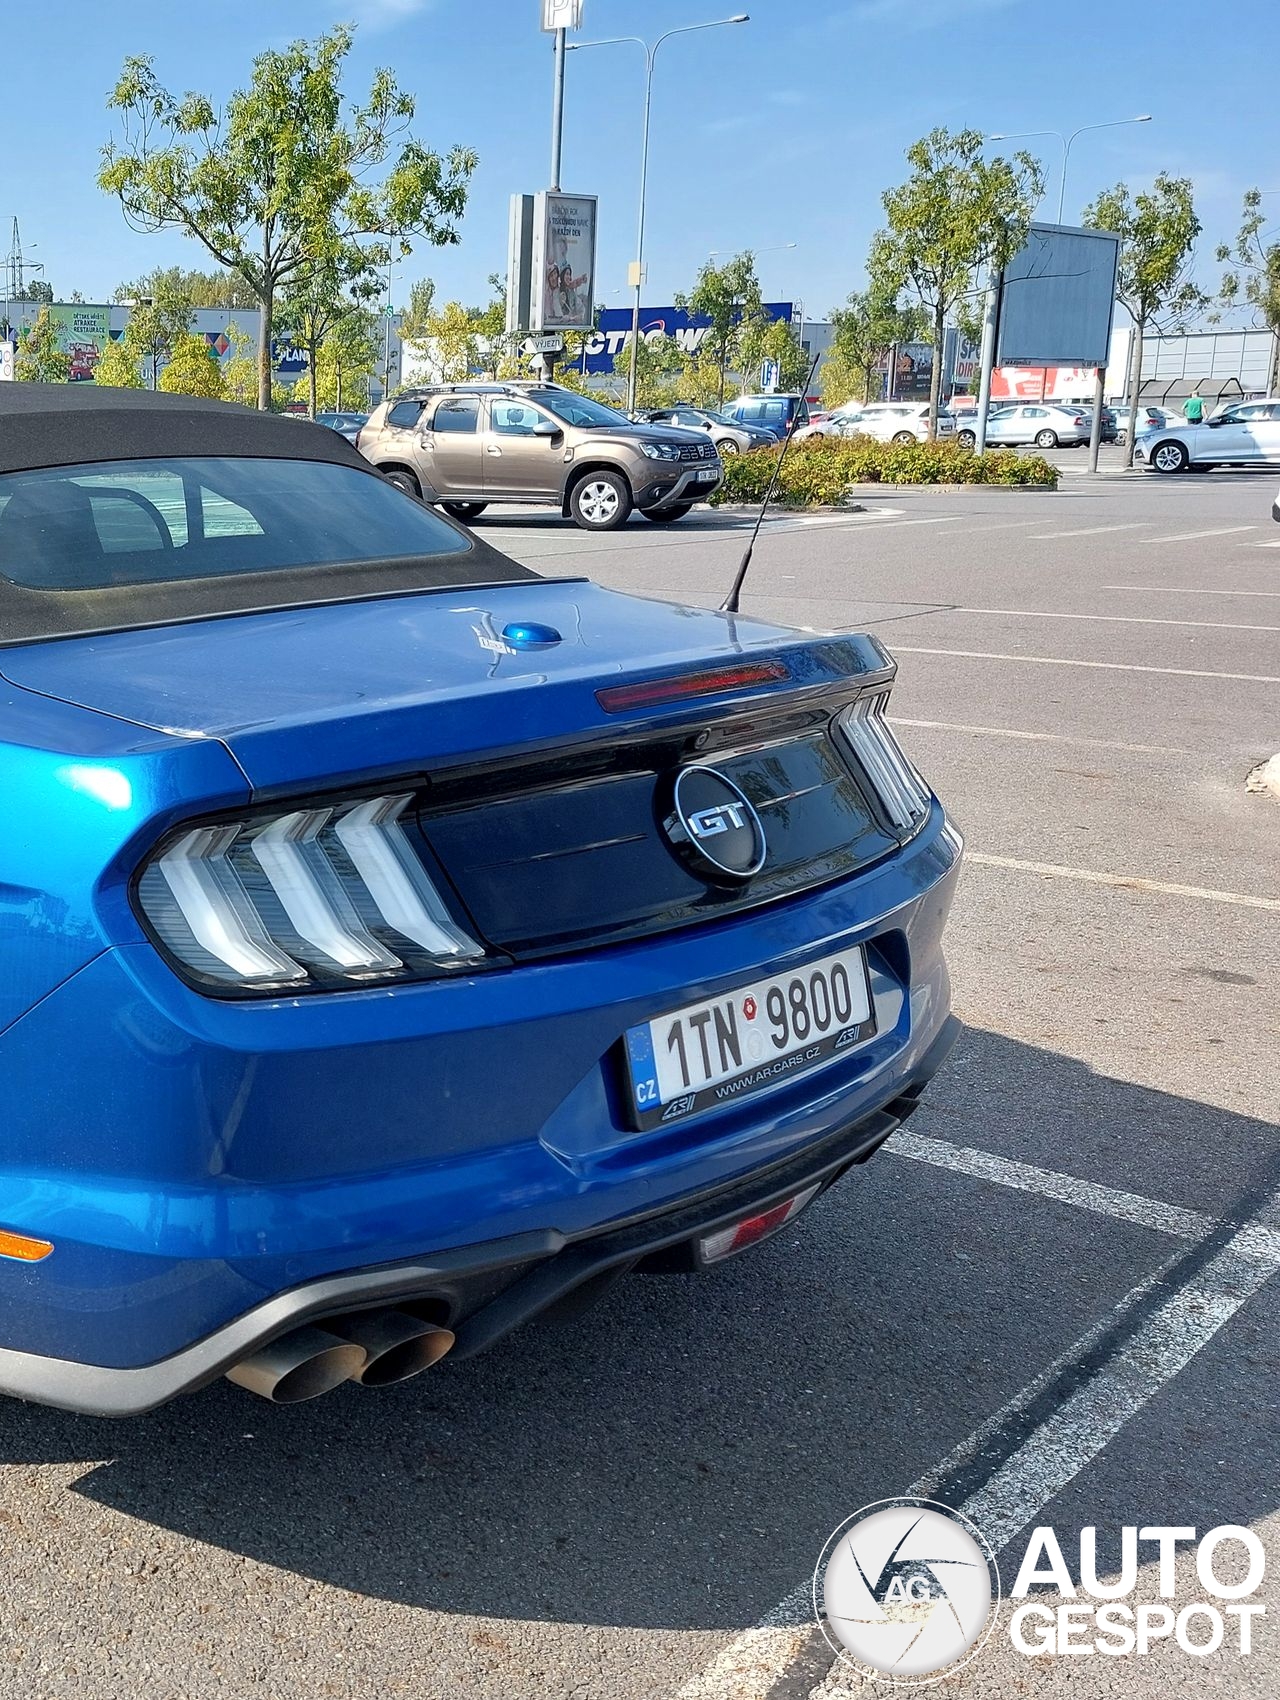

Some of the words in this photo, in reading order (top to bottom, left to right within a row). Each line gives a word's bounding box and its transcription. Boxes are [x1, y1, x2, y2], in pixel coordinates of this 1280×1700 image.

[687, 801, 744, 838] GT
[667, 1000, 743, 1088] 1TN
[766, 961, 852, 1050] 9800
[636, 1079, 657, 1104] CZ
[715, 1045, 821, 1099] WWW.AR-CARS.CZ
